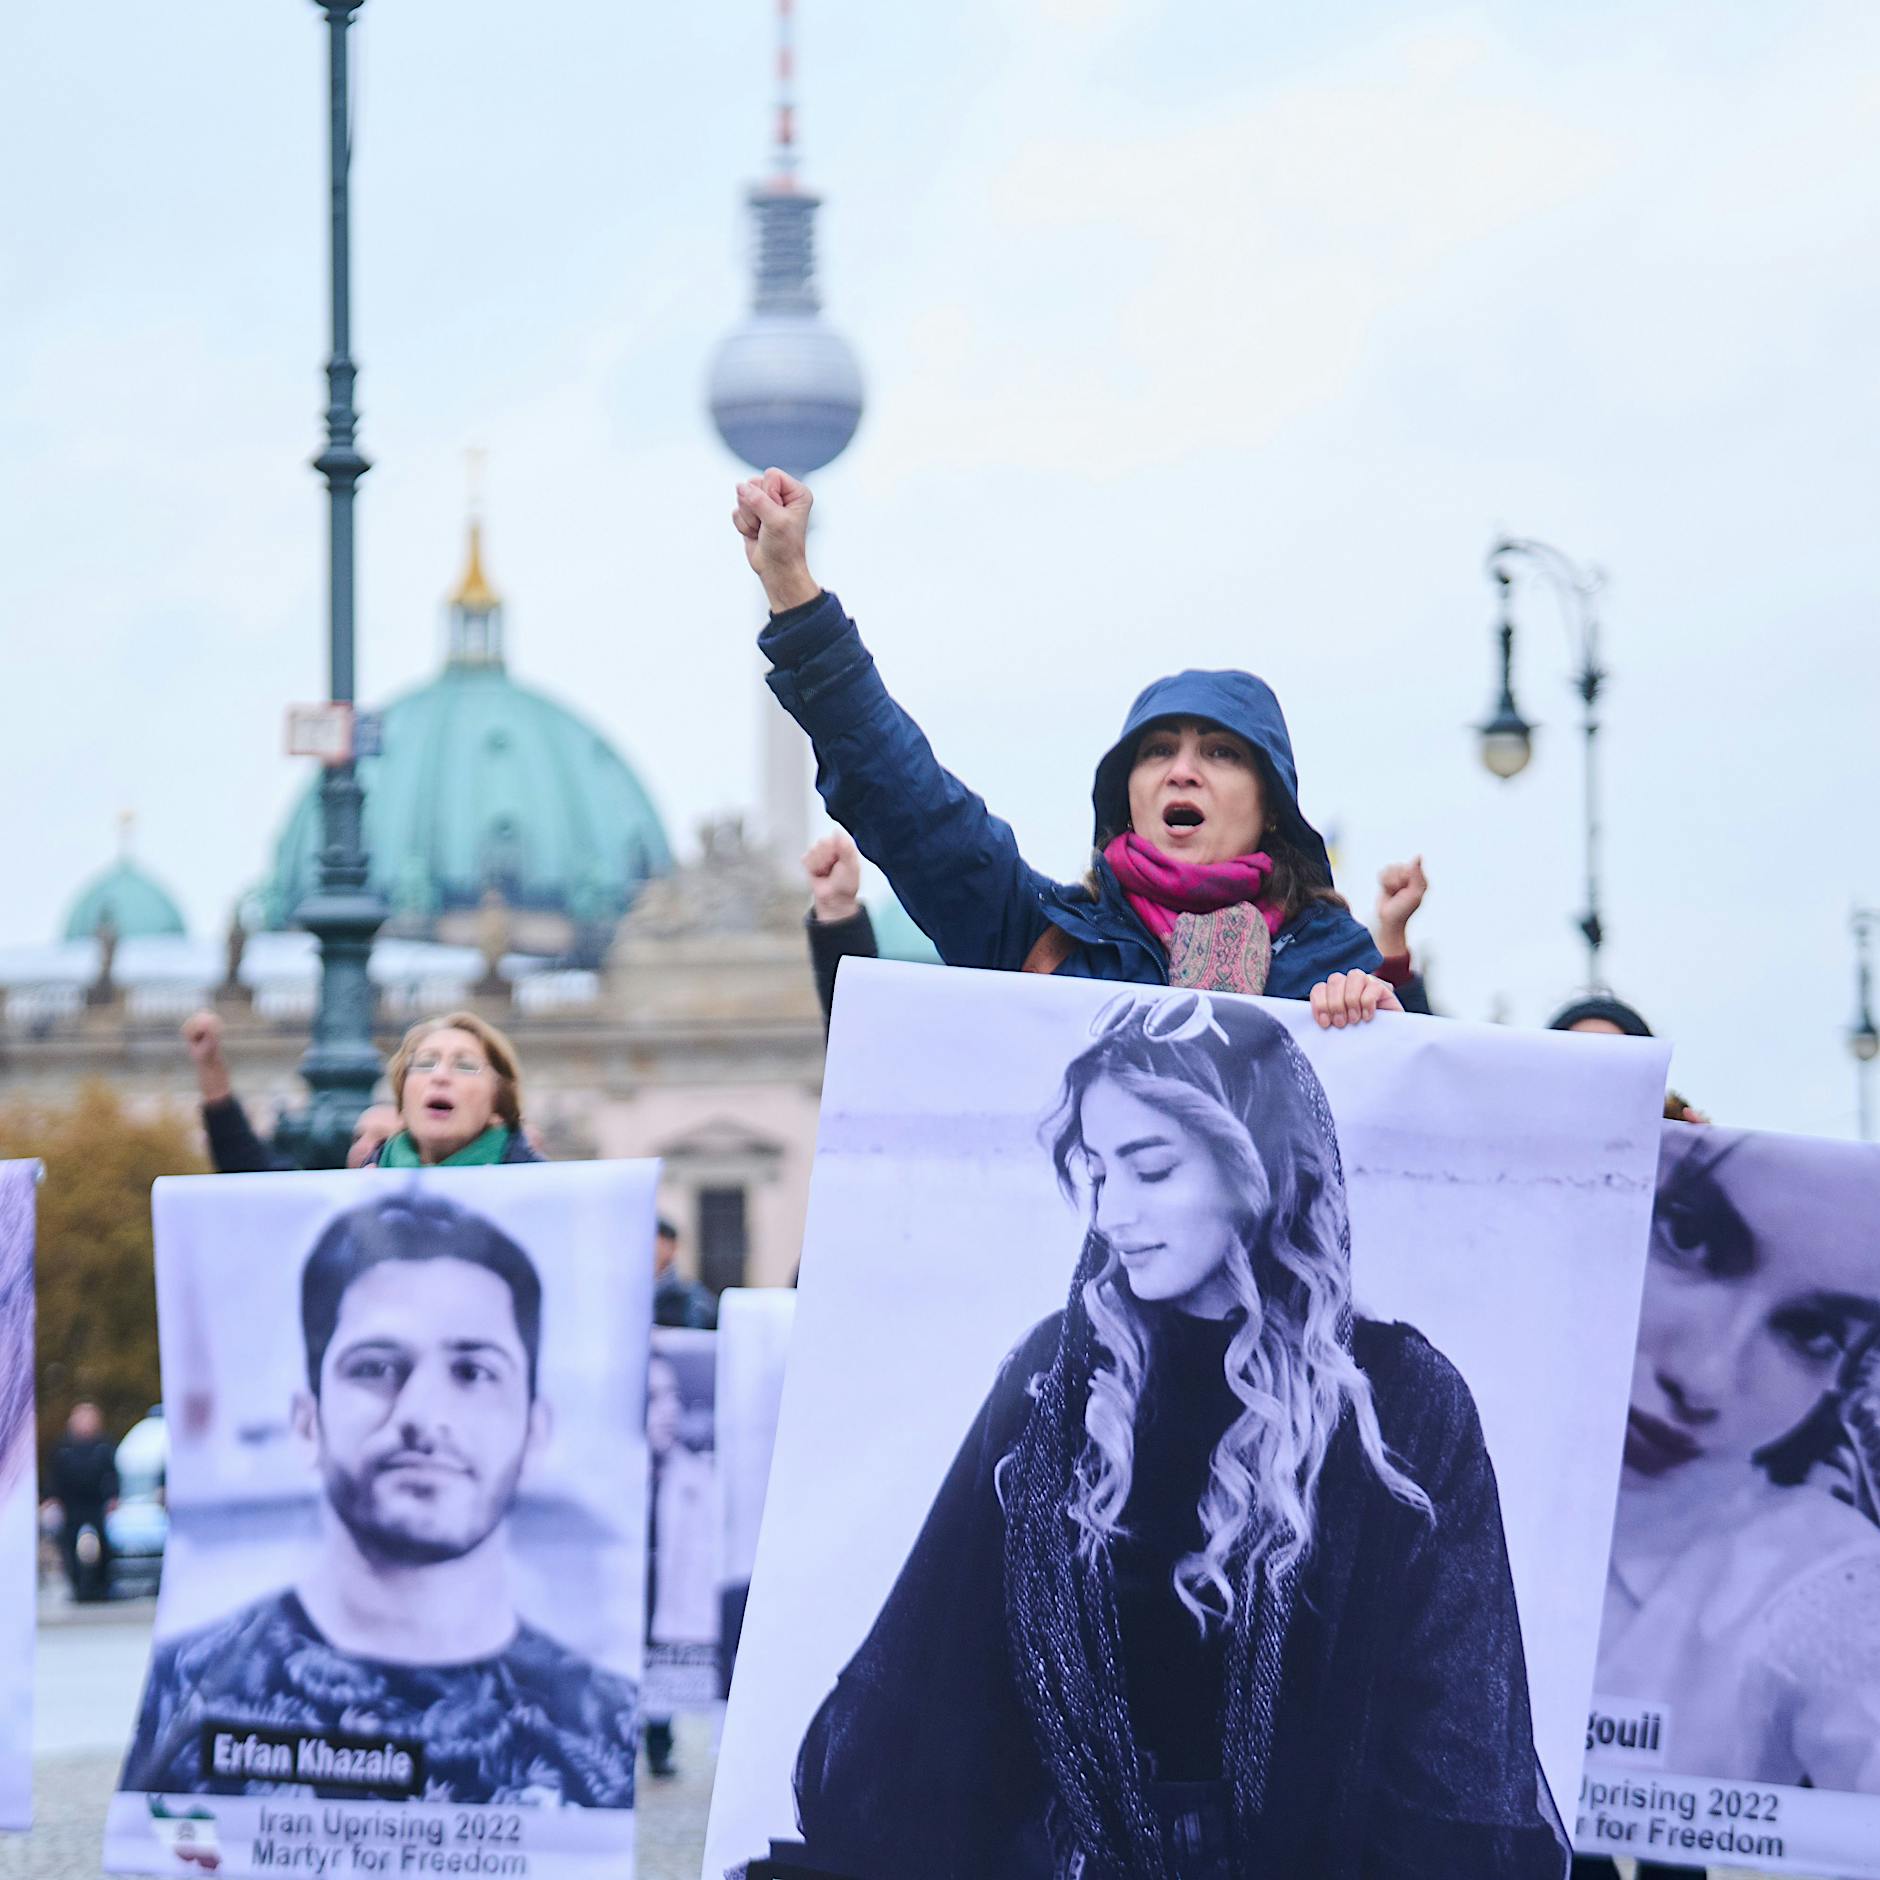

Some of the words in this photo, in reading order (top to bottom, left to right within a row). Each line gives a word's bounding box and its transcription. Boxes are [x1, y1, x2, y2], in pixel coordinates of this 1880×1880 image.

[213, 1733, 292, 1775] Erfan
[260, 1805, 312, 1833] Iran
[323, 1807, 442, 1845] Uprising
[455, 1812, 520, 1841] 2022
[1708, 1788, 1779, 1822] 2022
[1595, 1812, 1638, 1841] for
[1648, 1817, 1783, 1857] Freedom
[252, 1838, 342, 1873] Martyr
[352, 1842, 390, 1870] for
[401, 1844, 526, 1874] Freedom
